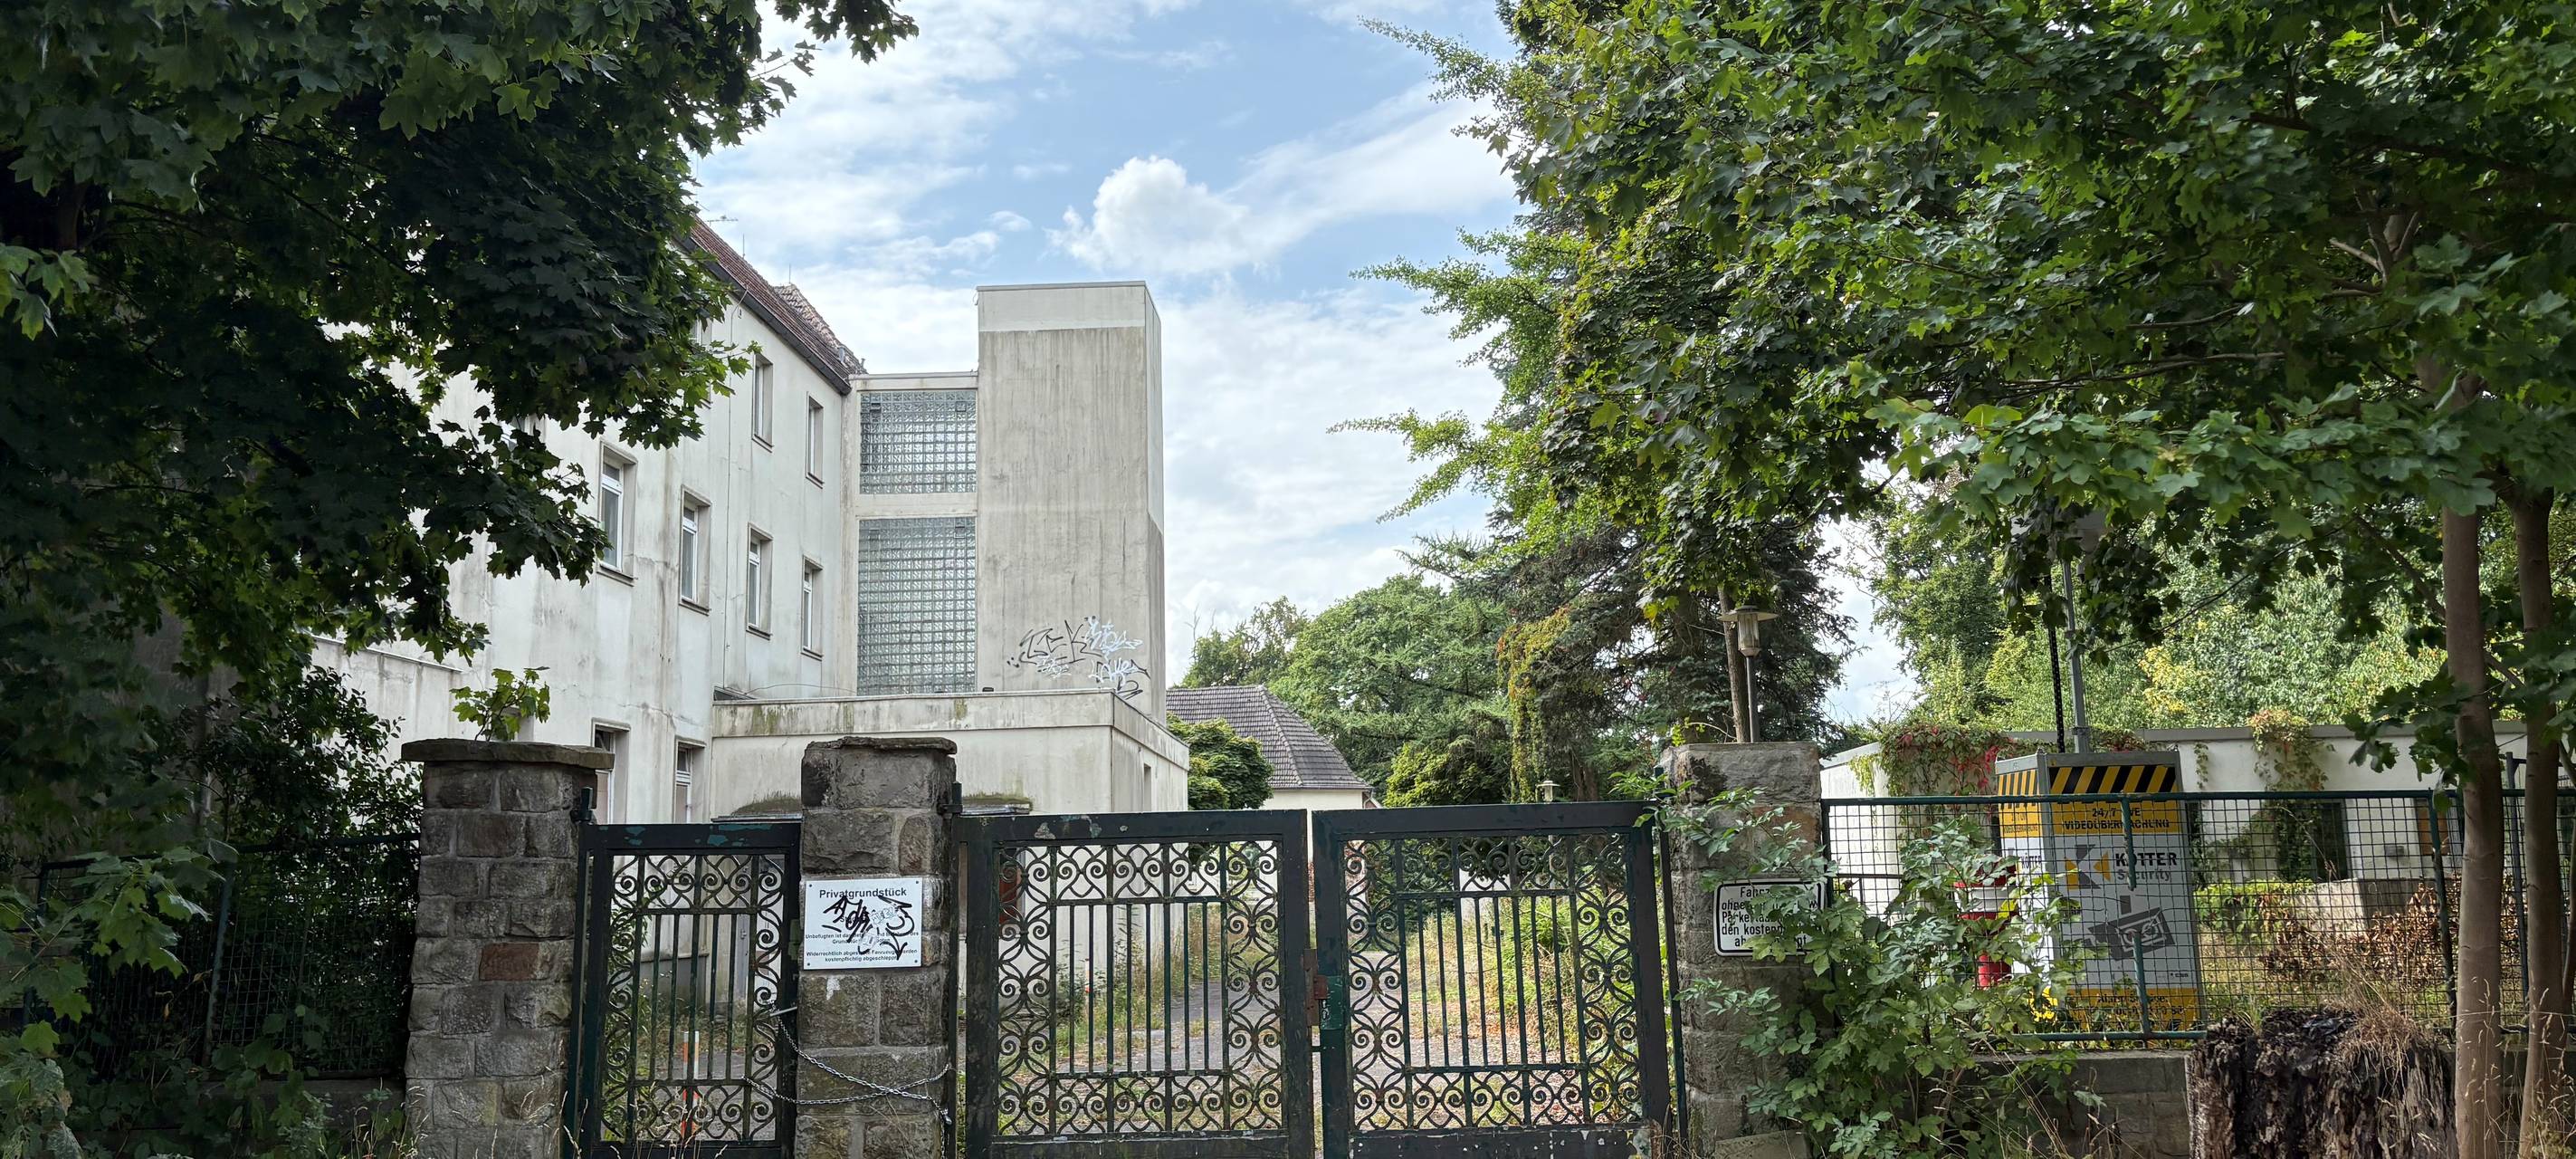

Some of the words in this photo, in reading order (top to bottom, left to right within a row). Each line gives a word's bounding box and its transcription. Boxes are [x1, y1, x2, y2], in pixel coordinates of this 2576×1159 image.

[2092, 808, 2116, 819] 24/7
[2065, 819, 2170, 830] VIDEOÜBERACHUNG
[2115, 852, 2178, 867] KTTER
[2117, 869, 2171, 882] Scurity
[819, 887, 907, 899] Privatgrundstück
[1722, 899, 1746, 911] ohne
[1722, 924, 1740, 935] den
